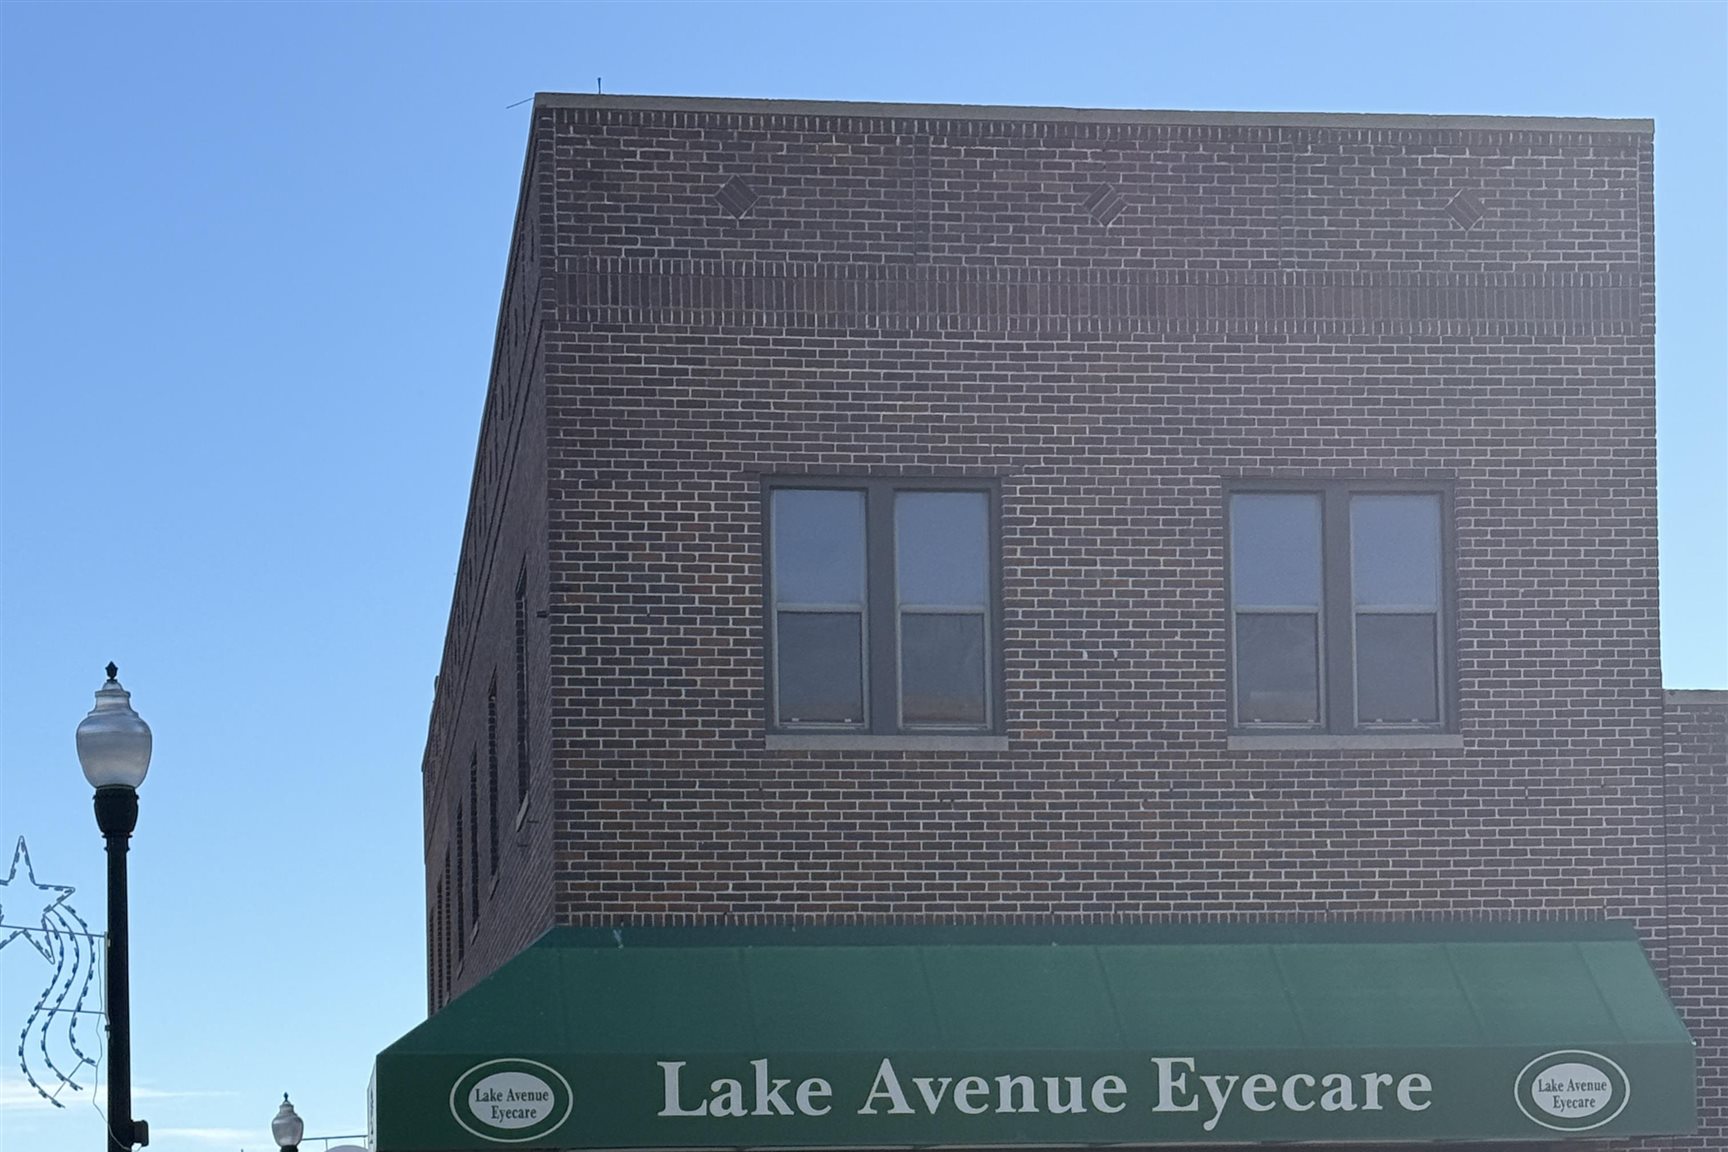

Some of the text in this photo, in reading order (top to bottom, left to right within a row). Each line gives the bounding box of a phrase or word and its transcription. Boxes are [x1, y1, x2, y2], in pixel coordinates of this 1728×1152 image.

[656, 1056, 1433, 1132] Lake Avenue Eyecare
[1538, 1078, 1608, 1093] Lake Avenue
[475, 1088, 549, 1102] Lake Avenue
[1553, 1095, 1596, 1112] Eyecare
[491, 1105, 537, 1123] Eyecare
